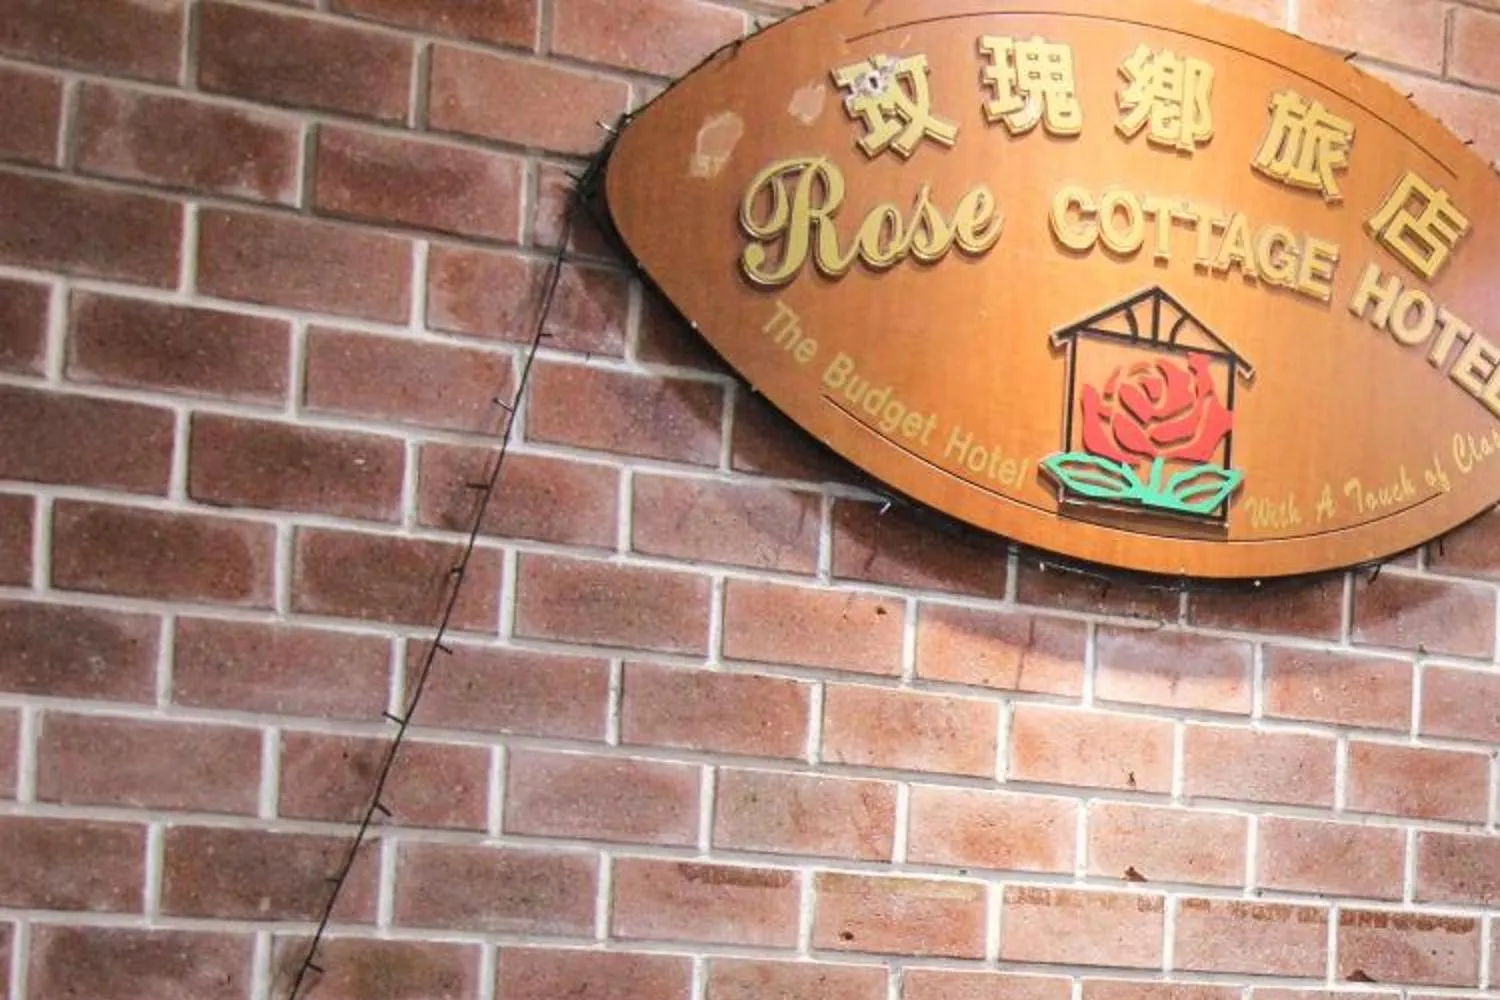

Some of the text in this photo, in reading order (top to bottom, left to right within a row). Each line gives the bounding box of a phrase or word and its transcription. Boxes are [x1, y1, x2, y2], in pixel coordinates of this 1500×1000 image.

[738, 155, 1002, 286] Rose
[1049, 184, 1341, 301] COTTAGE
[762, 300, 1031, 489] The Budget Hotel
[1244, 494, 1300, 529] With
[1316, 482, 1337, 523] A
[1343, 464, 1416, 513] Touch
[1425, 455, 1451, 492] of
